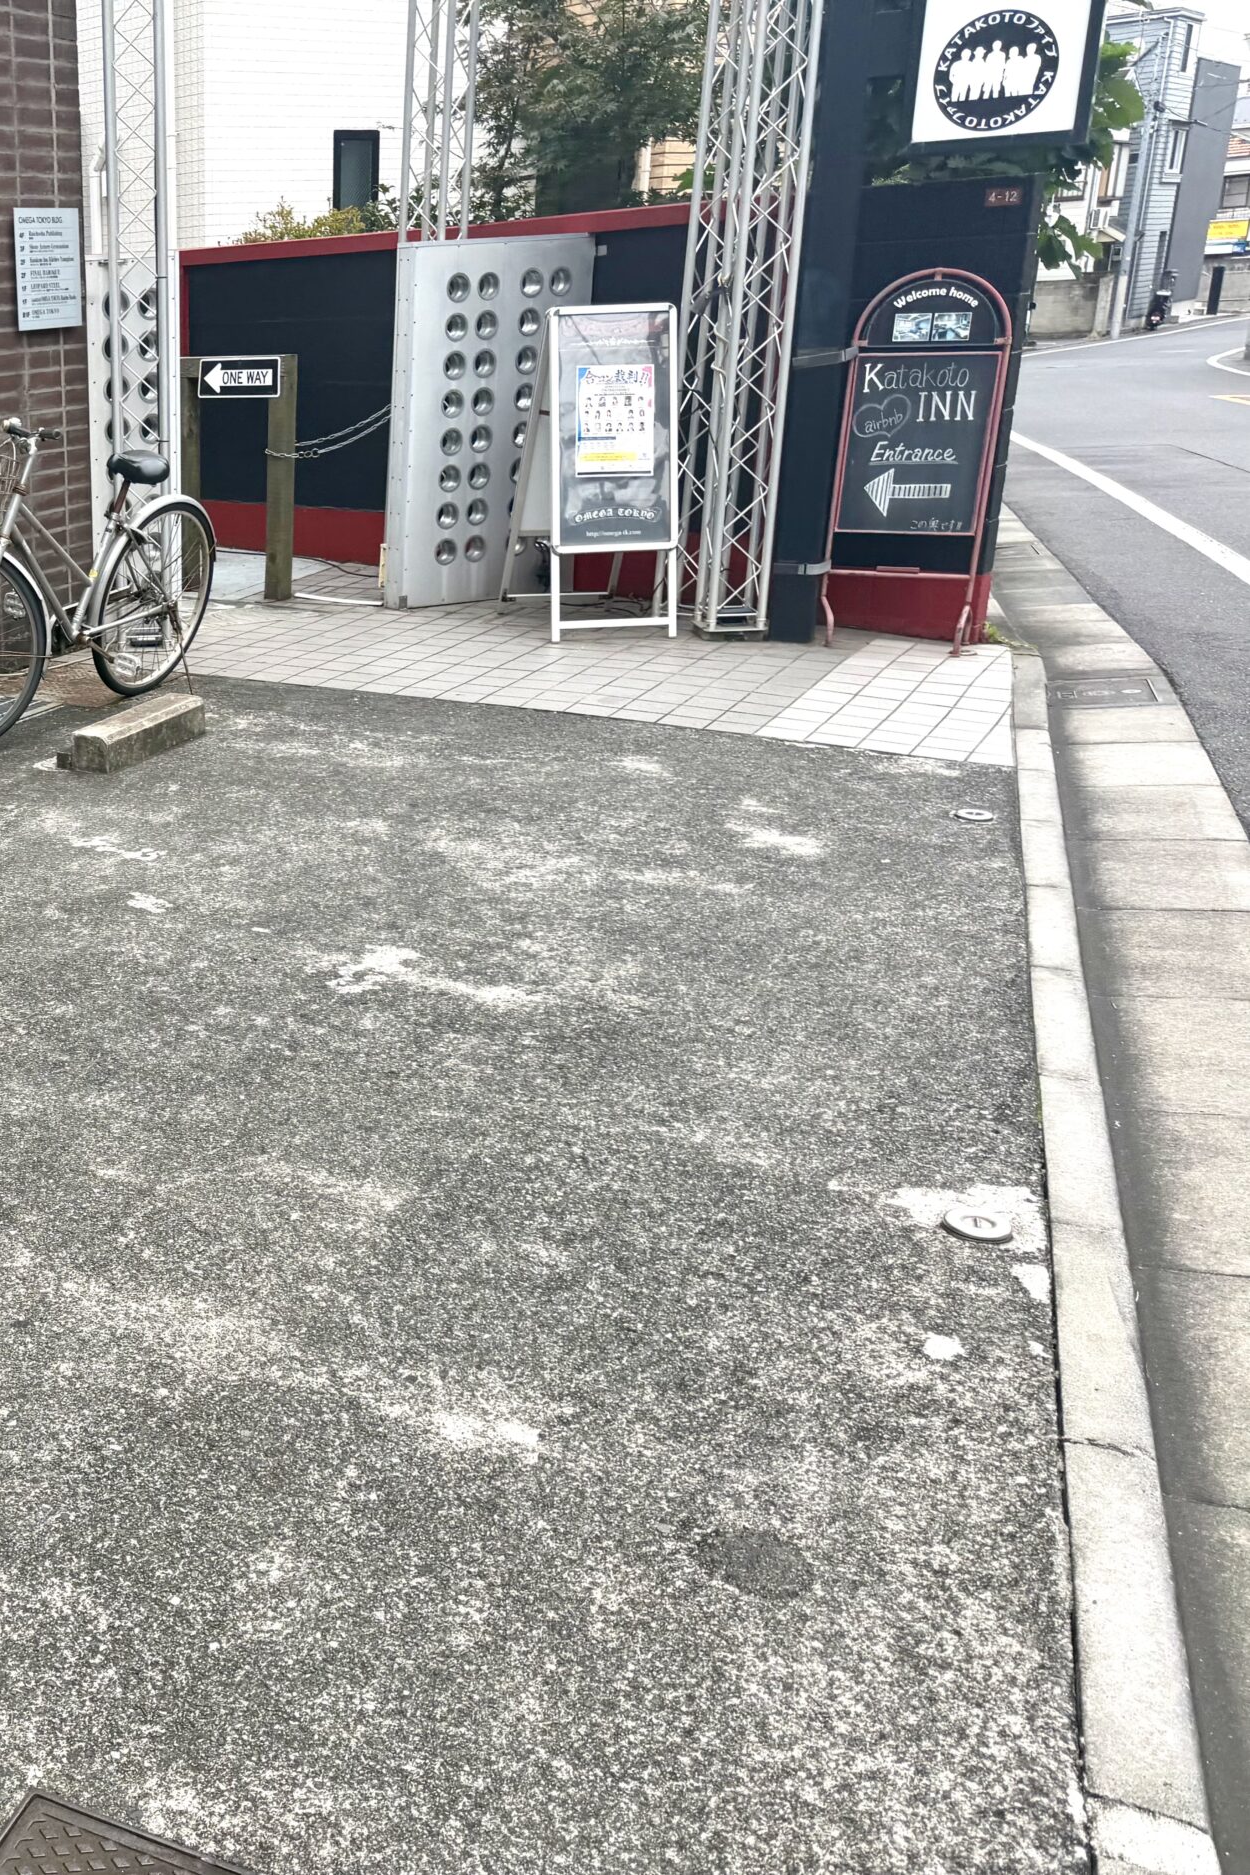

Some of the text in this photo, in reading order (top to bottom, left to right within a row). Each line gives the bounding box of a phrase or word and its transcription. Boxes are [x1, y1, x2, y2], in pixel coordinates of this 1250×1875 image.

[988, 190, 1017, 203] 4-12
[18, 216, 35, 224] OMEGA
[36, 216, 51, 224] TOKYO
[893, 286, 979, 309] Welcome home
[222, 370, 268, 385] ONE WAY
[862, 362, 970, 393] Katakoto
[916, 390, 977, 422] INN
[864, 409, 903, 433] airbnb
[870, 441, 956, 461] Entrance
[574, 508, 655, 523] OMEGA TOKYO
